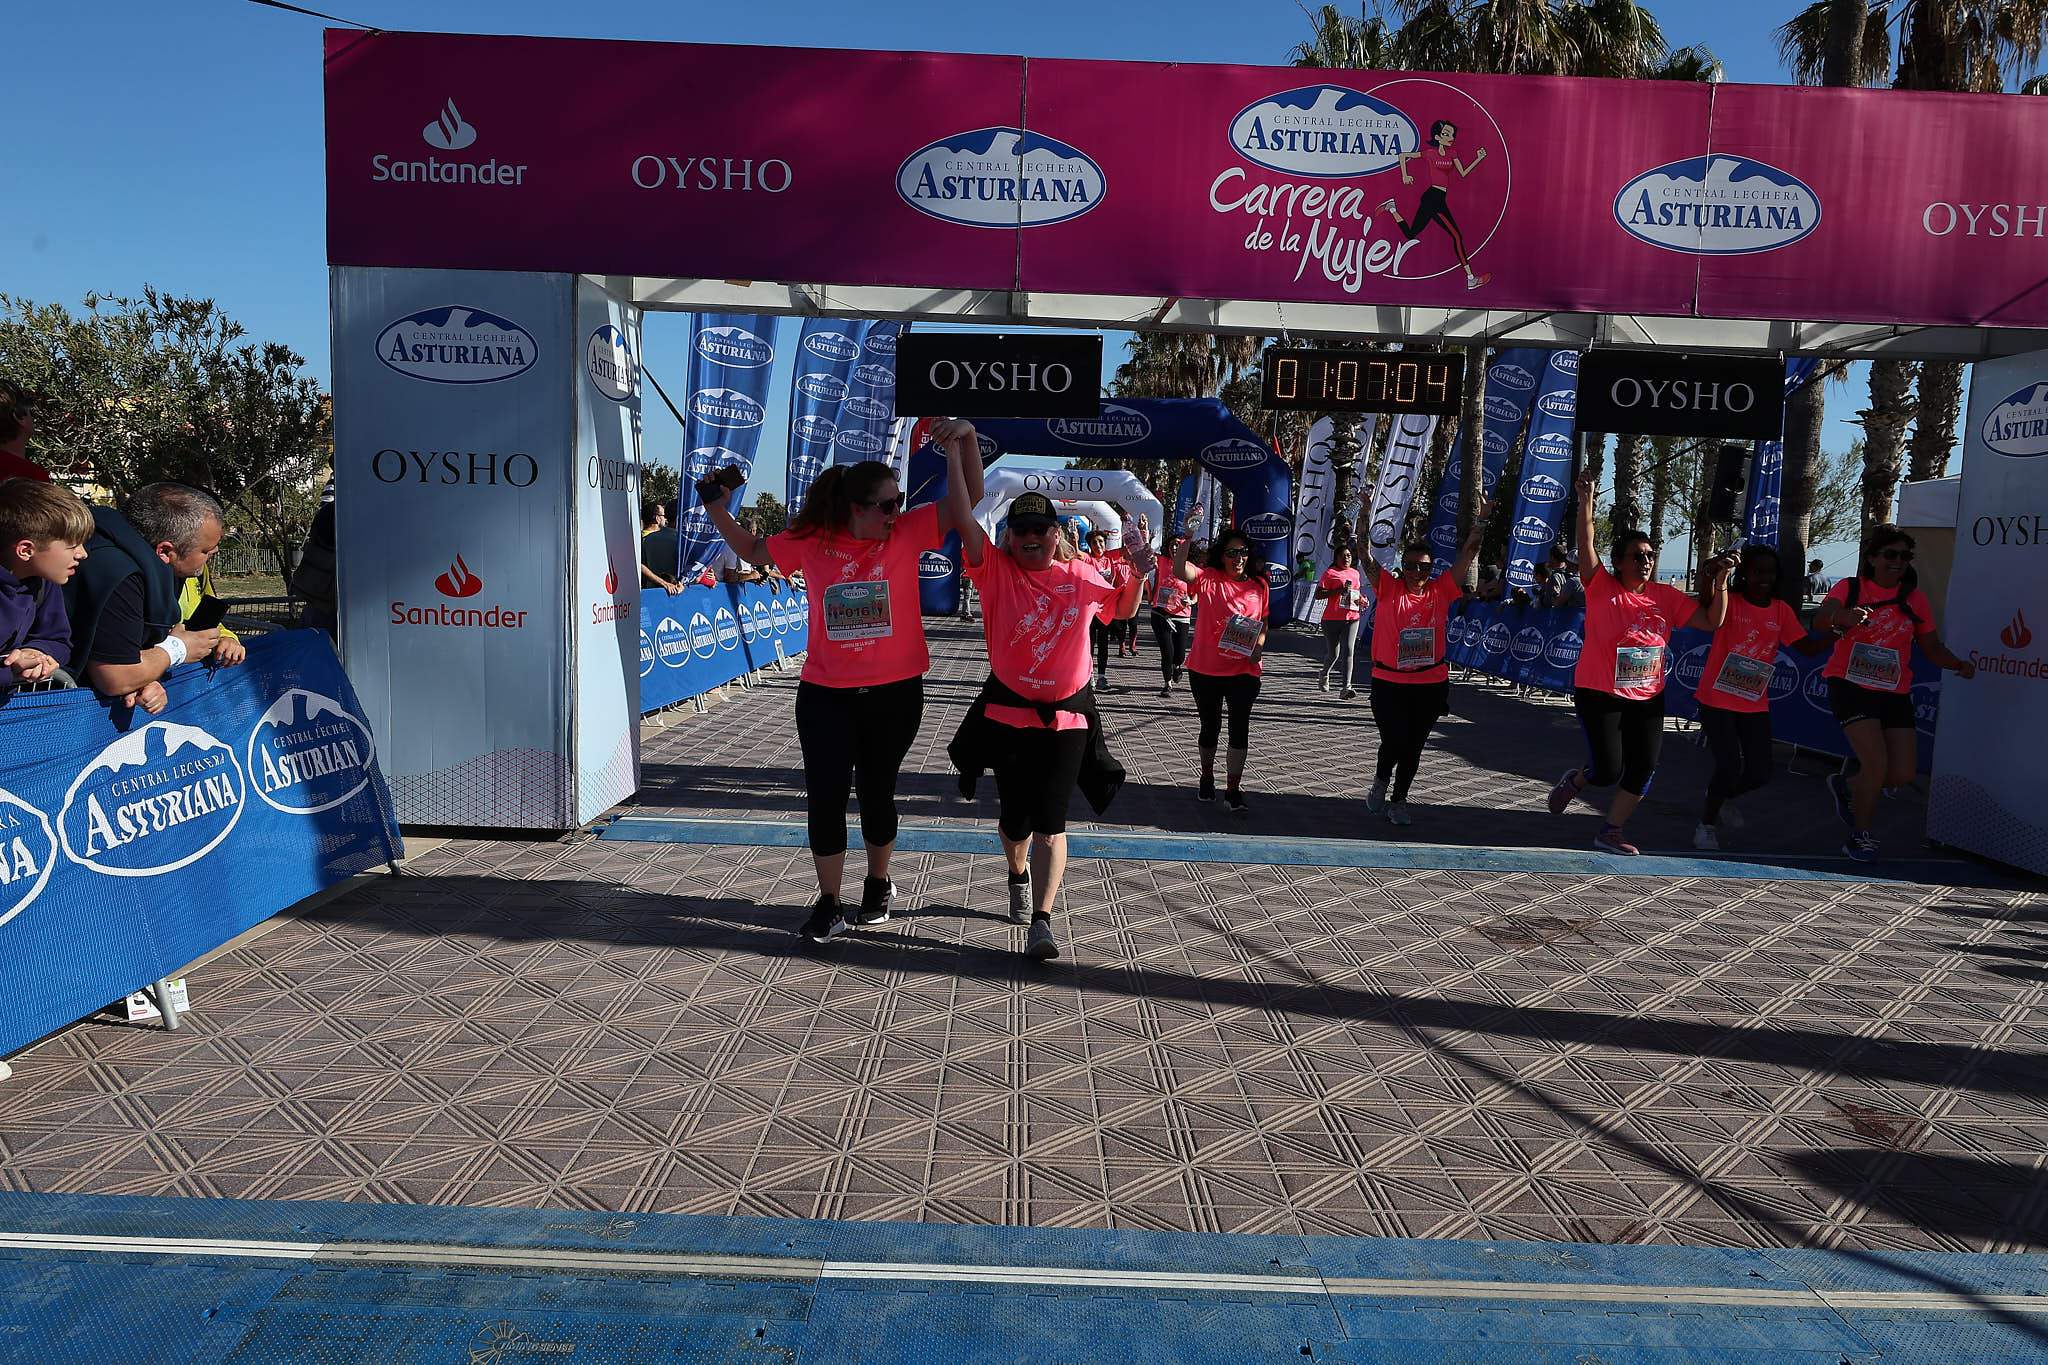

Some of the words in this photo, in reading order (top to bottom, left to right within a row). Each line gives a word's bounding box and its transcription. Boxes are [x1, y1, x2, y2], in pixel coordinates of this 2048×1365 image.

[1243, 115, 1401, 156] ASTURIANA
[1274, 115, 1334, 126] CENTRAL
[1339, 117, 1399, 129] LECHERA
[372, 155, 527, 185] Santander
[631, 155, 793, 193] OYSHO
[911, 162, 1089, 203] ASTURIANA
[945, 160, 1010, 172] CENTRAL
[1016, 161, 1084, 174] LECHERA
[1209, 167, 1364, 218] Carrera
[1628, 188, 1804, 230] ASTURIANA
[1663, 187, 1726, 199] CENTRAL
[1733, 189, 1799, 201] LECHERA
[1922, 201, 2048, 238] OYSH
[1244, 219, 1275, 251] de
[1279, 218, 1301, 252] la
[1293, 217, 1421, 294] Mujer
[388, 333, 526, 366] ASTURIANA
[413, 331, 465, 341] CENTRAL
[469, 333, 521, 343] LECHERA
[699, 335, 766, 361] ASTURIANA
[929, 360, 1072, 393] OYSHO
[1276, 358, 1448, 402] 01:07:04
[693, 397, 760, 423] ASTURIANA
[1611, 377, 1755, 412] OYSHO
[1055, 418, 1143, 437] ASTURIANA
[372, 449, 539, 488] OYSHO
[588, 455, 635, 493] OYSHO
[1024, 474, 1104, 493] OYSHO
[1972, 515, 2048, 547] OYSH
[919, 564, 950, 573] URIANA
[391, 602, 528, 628] Santander
[592, 600, 631, 625] Santander
[1969, 650, 2048, 679] Santande
[273, 731, 312, 749] CENTRAL
[112, 769, 171, 797] CENTRAL
[174, 753, 226, 780] LECHERA
[261, 739, 362, 793] ASTURIAN
[85, 772, 239, 857] ASTURIANA
